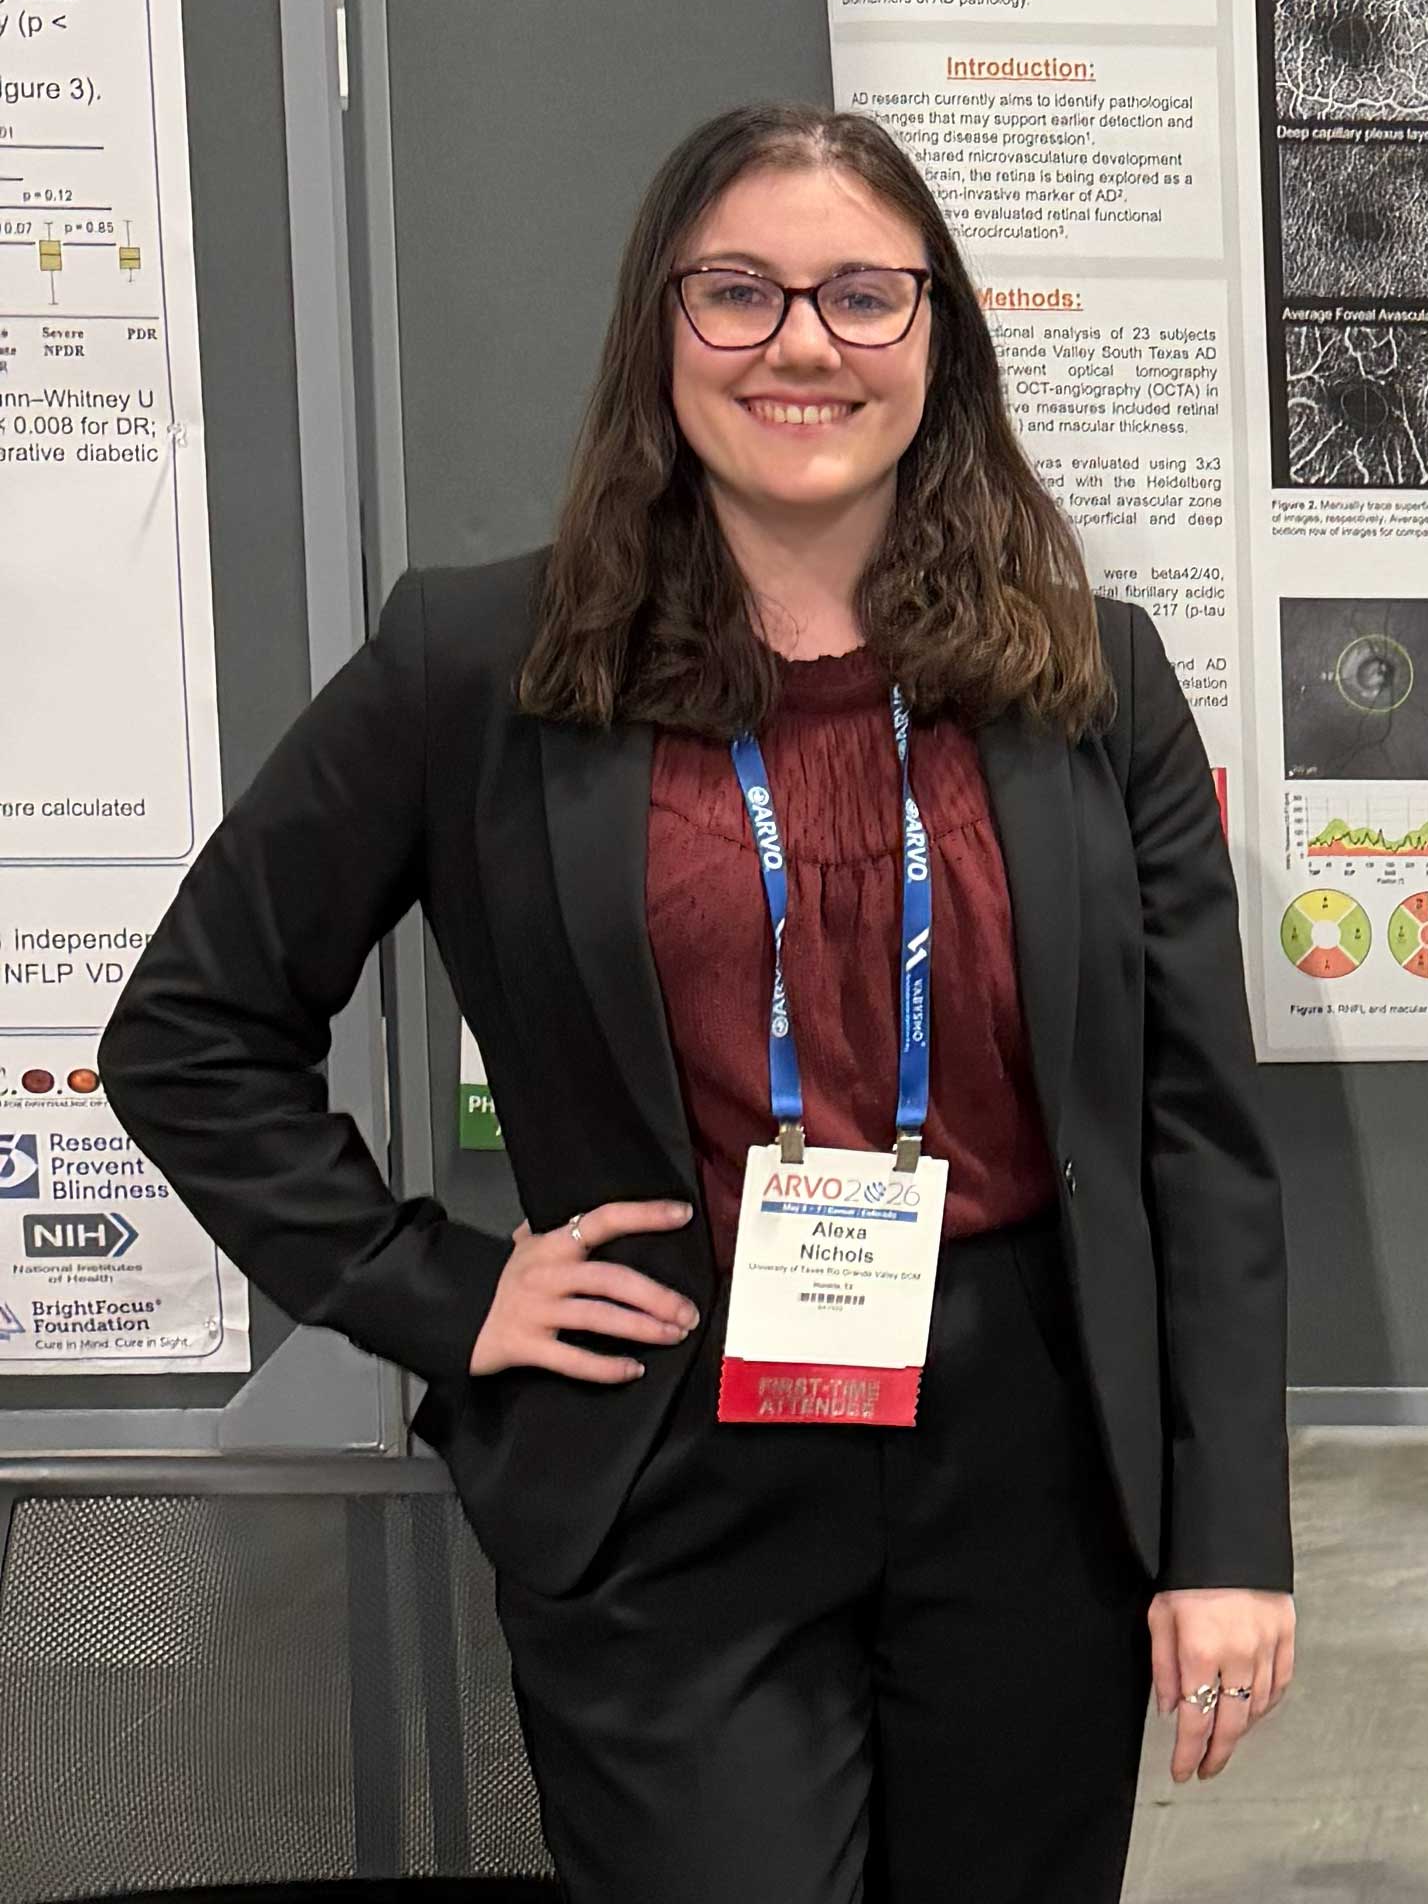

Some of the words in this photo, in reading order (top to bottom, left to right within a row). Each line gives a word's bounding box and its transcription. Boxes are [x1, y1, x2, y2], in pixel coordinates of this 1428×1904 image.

[947, 57, 1096, 82] Introduction:
[70, 78, 102, 106] 3).
[42, 327, 84, 339] Severe
[127, 328, 157, 340] PDR
[44, 345, 85, 357] NPDR
[138, 389, 154, 408] U
[14, 416, 73, 435] 0.008
[81, 416, 108, 435] for
[116, 417, 156, 438] DR;
[77, 443, 158, 463] diabetic
[41, 798, 146, 817] calculated
[5, 963, 73, 984] NFLP
[86, 963, 124, 983] VD
[52, 1157, 144, 1176] Prevent
[52, 1181, 170, 1200] Blindness
[763, 1173, 842, 1200] ARVO
[33, 1223, 106, 1248] NIH
[812, 1221, 867, 1240] Alexa
[800, 1244, 874, 1264] Nichols
[34, 1317, 150, 1334] Foundation
